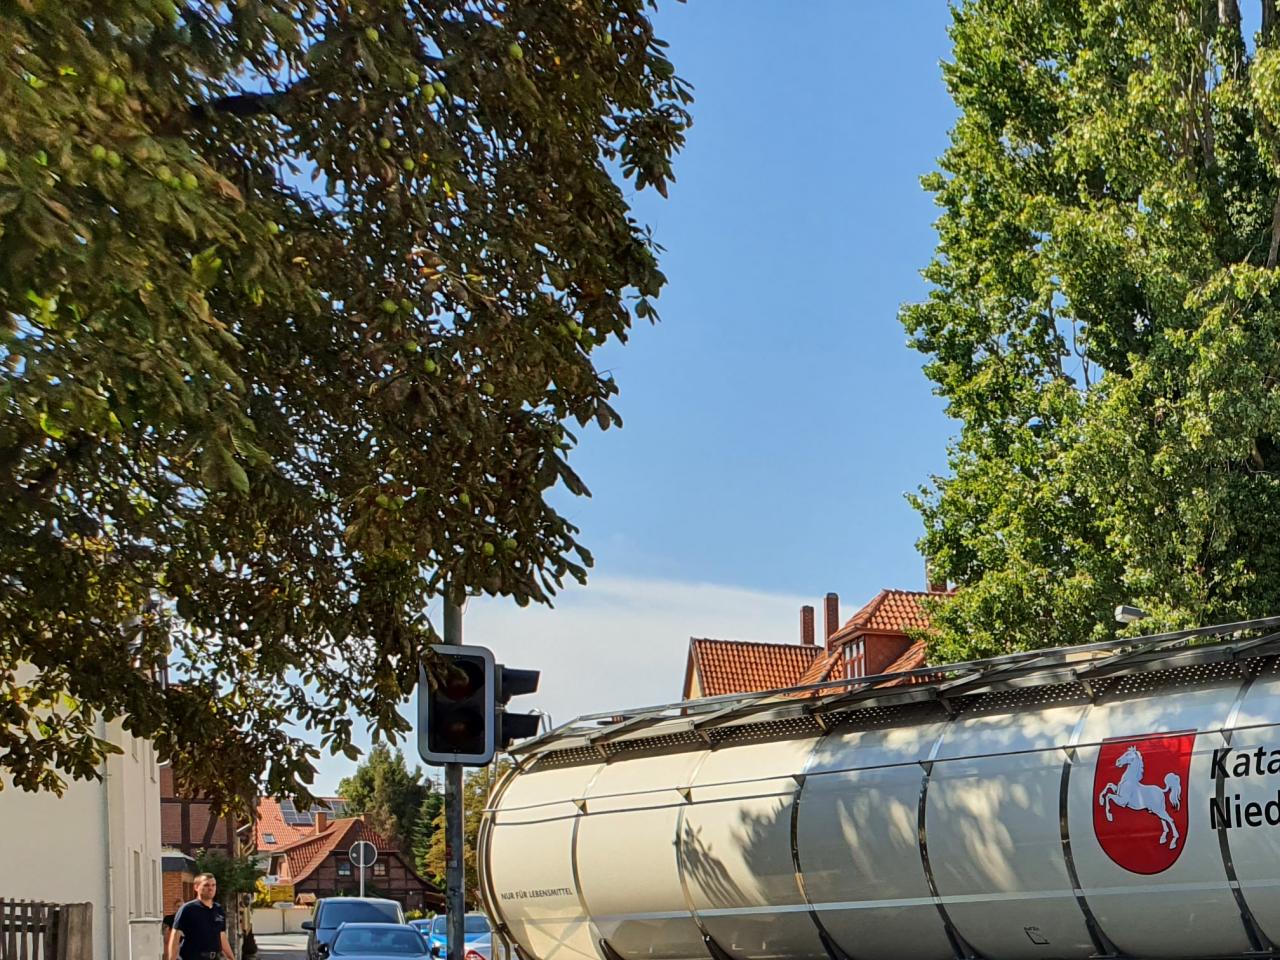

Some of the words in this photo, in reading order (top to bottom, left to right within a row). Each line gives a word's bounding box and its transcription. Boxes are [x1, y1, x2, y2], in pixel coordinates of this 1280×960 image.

[500, 891, 515, 900] NUR
[515, 889, 528, 899] FÜR
[528, 887, 573, 898] LEBENSMITTEL
